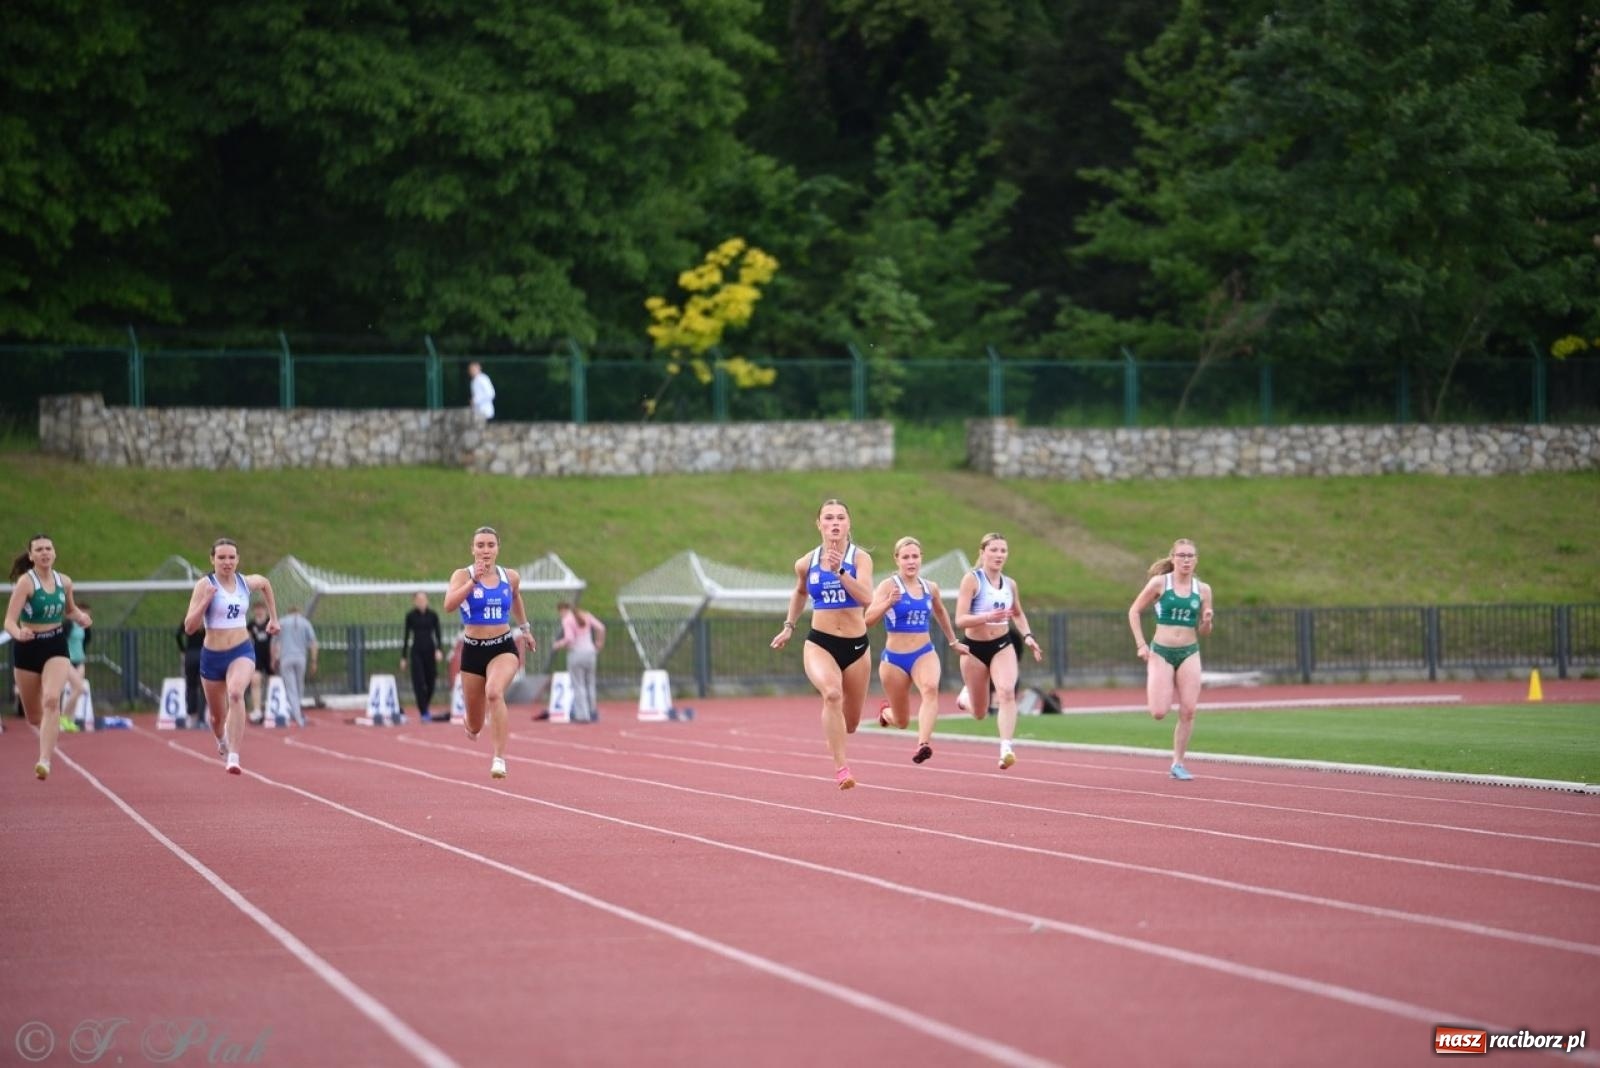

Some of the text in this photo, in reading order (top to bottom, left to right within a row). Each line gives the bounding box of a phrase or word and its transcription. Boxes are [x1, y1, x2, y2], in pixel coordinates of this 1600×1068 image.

[821, 589, 846, 604] 320
[226, 603, 241, 620] 25
[906, 610, 928, 626] 155
[1170, 607, 1191, 622] 112
[480, 636, 503, 647] NIKE
[165, 688, 180, 715] 6
[553, 683, 564, 710] 2
[646, 681, 656, 708] 1
